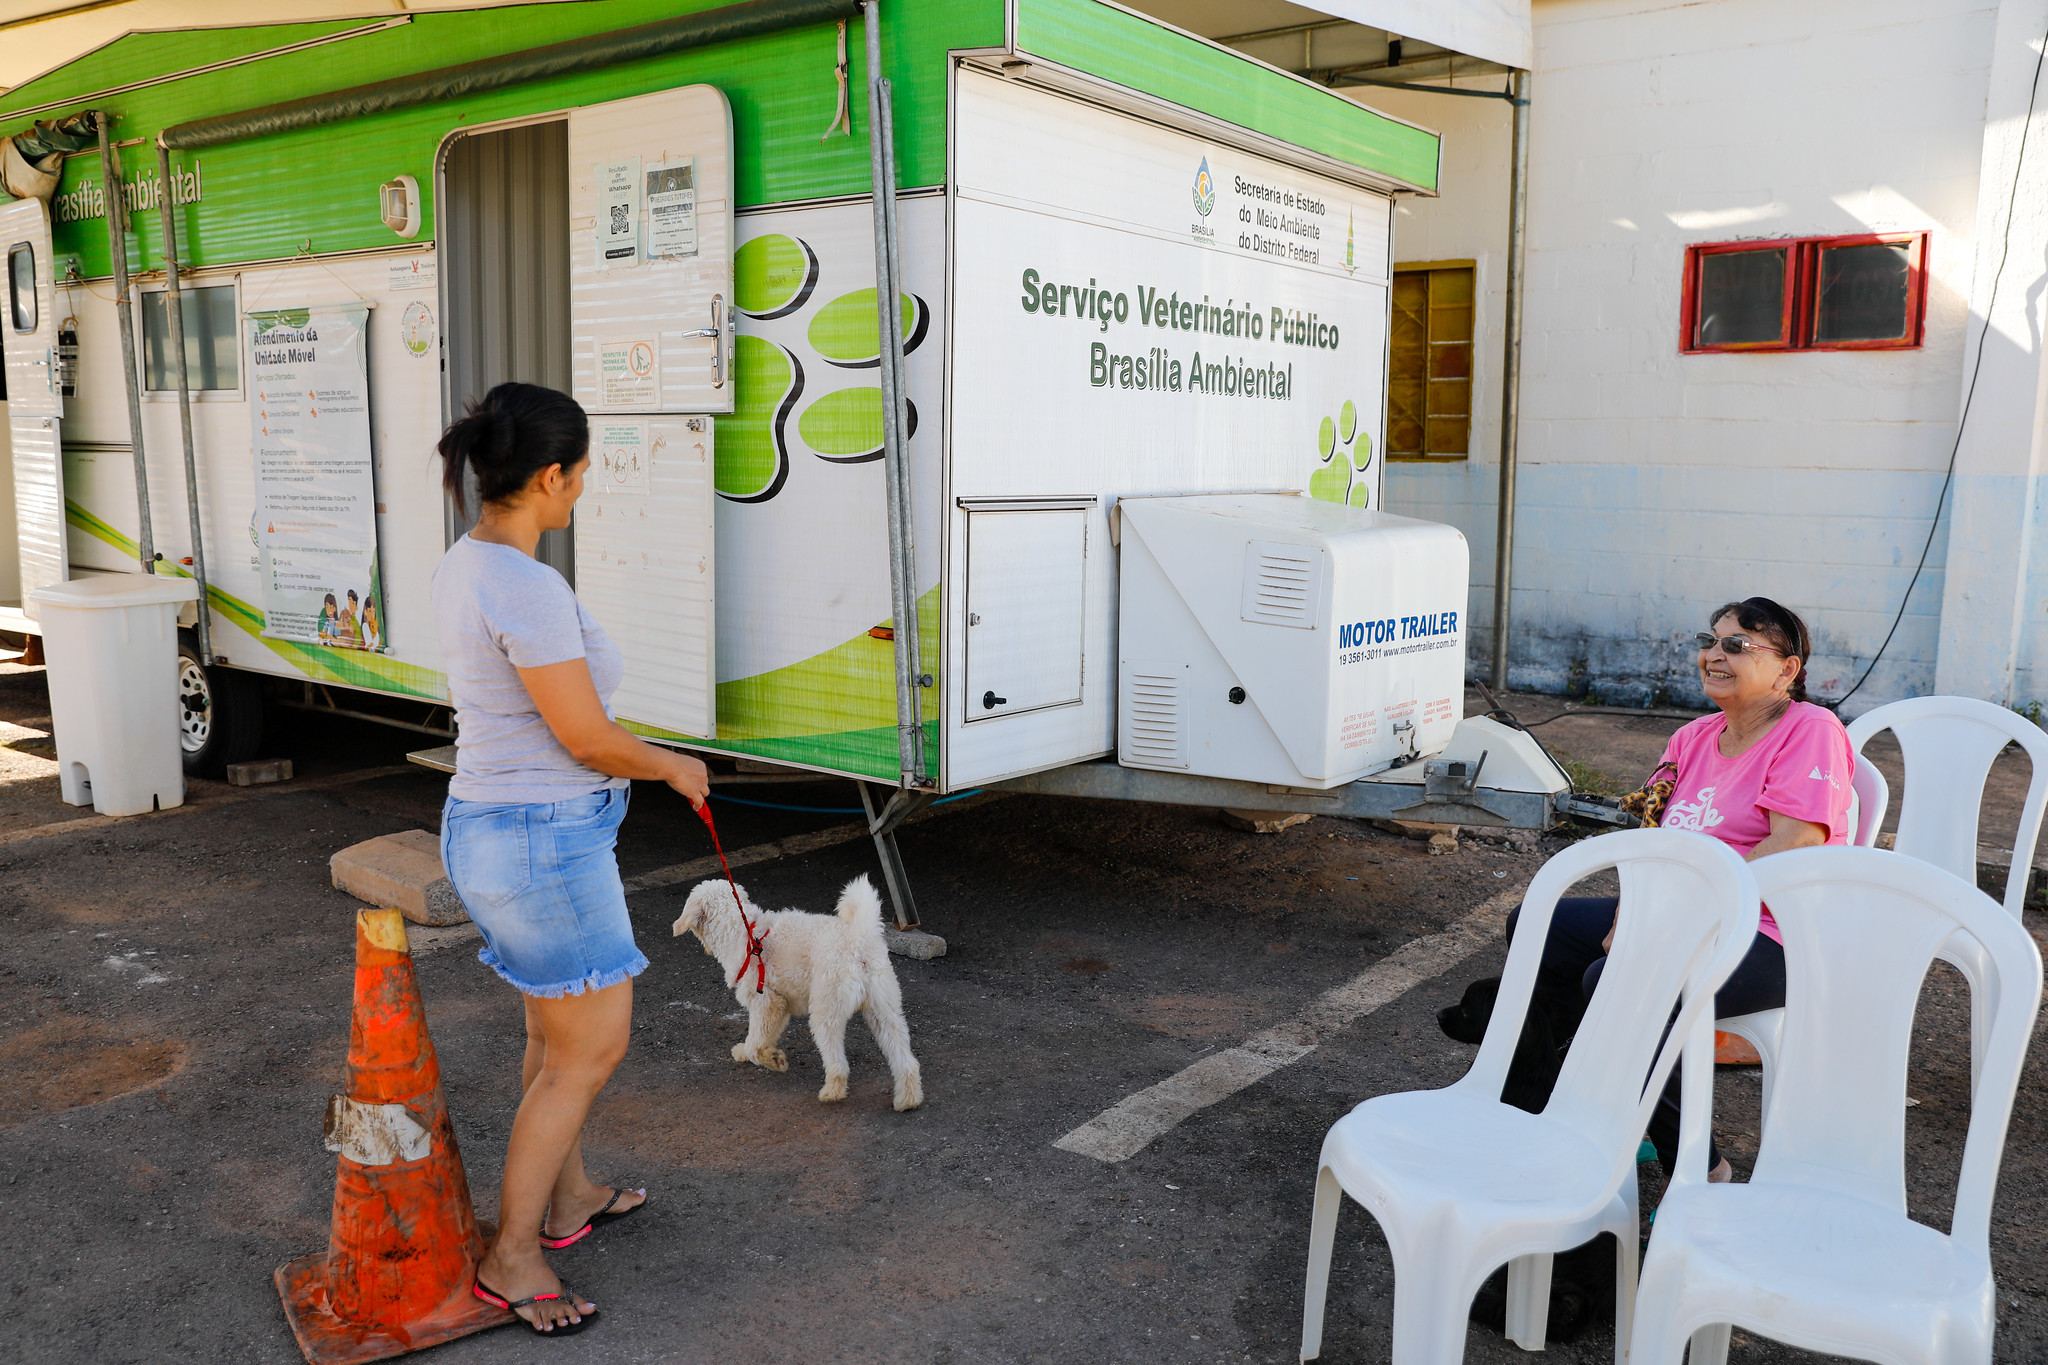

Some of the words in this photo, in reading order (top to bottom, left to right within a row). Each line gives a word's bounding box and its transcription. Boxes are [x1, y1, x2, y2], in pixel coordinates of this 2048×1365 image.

[50, 179, 105, 224] rasília
[121, 159, 202, 214] mbiental
[608, 184, 632, 193] Whatsapp
[1234, 175, 1281, 205] Secretaria
[1283, 189, 1294, 208] de
[1296, 192, 1326, 216] Estado
[1191, 224, 1215, 238] BRASÍLIA
[1238, 204, 1251, 223] do
[1256, 208, 1278, 230] Meio
[1280, 214, 1320, 240] Ambiente
[1238, 231, 1250, 250] do
[1253, 234, 1286, 258] Distrito
[1288, 241, 1320, 265] Federal
[1020, 267, 1129, 334] Serviço
[1137, 284, 1264, 343] Veterinário
[1269, 306, 1341, 351] Público
[254, 329, 305, 346] Atendimento
[306, 327, 318, 342] da
[254, 350, 287, 366] Unidade
[288, 347, 316, 363] Móvel
[1089, 341, 1183, 392] Brasília
[1187, 350, 1294, 401] Ambiental
[1339, 618, 1396, 649] MOTOR
[1400, 611, 1458, 640] TRAILER
[1339, 654, 1347, 665] 19
[1348, 648, 1382, 664] 3561-3011
[1383, 637, 1458, 658] www.motortrailer.com.br
